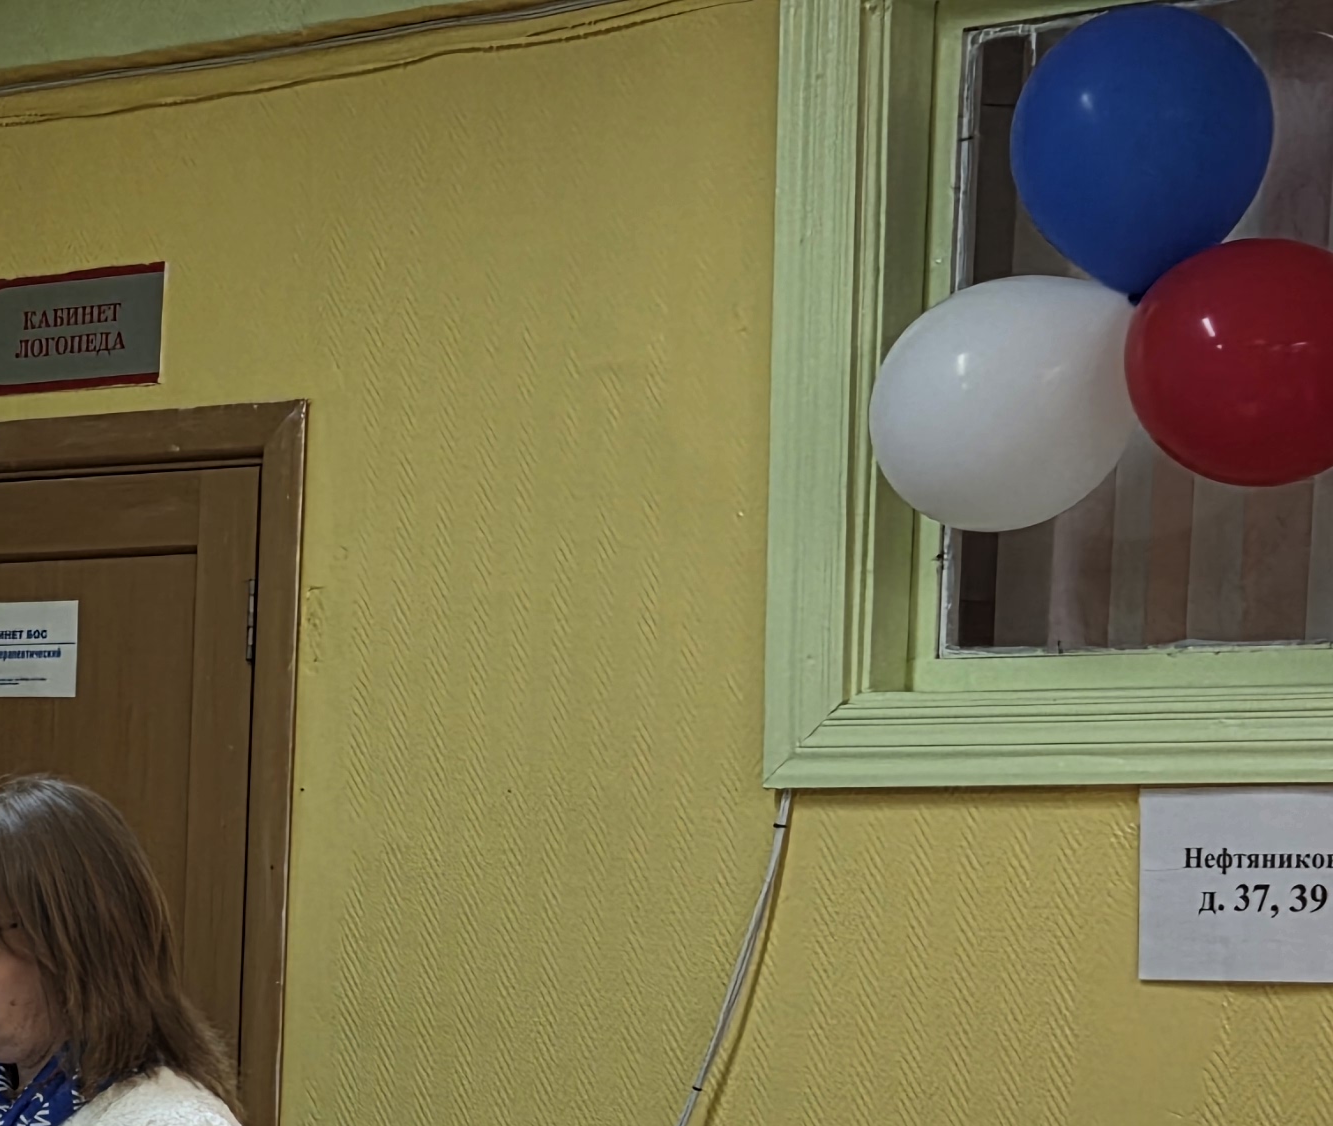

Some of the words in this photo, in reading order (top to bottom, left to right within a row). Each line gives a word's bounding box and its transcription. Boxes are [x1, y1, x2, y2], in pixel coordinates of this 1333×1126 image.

[23, 302, 122, 331] КАБИНЕТ
[15, 331, 126, 359] ЛОГОПЕДА
[26, 629, 48, 640] БОС
[1198, 891, 1225, 916] д.
[1233, 883, 1280, 919] 37,
[1288, 883, 1328, 914] 39
